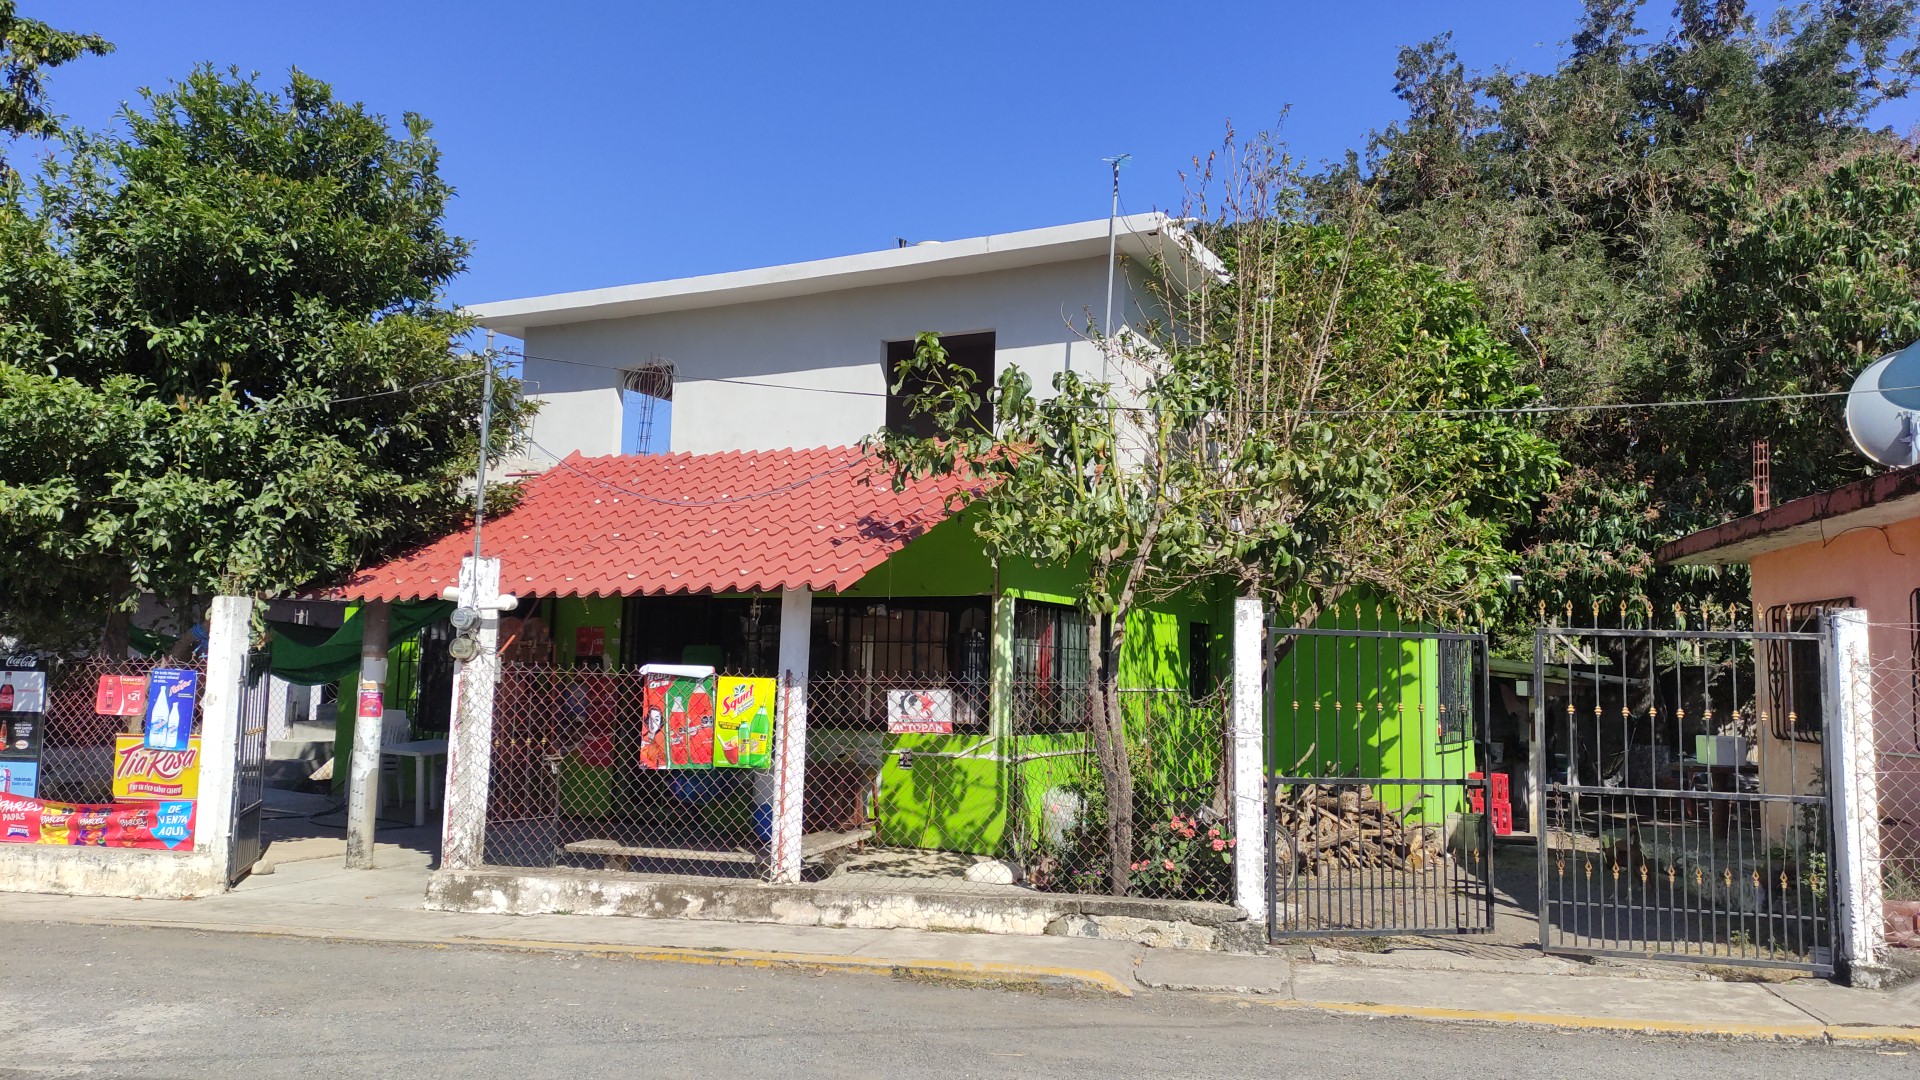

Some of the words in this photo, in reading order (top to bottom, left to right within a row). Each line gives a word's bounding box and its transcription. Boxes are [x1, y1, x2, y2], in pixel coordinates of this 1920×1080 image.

[722, 683, 756, 715] Squirt
[893, 723, 943, 731] ACTOPAN
[147, 749, 197, 779] Rosa
[153, 785, 166, 793] sabor
[167, 805, 182, 813] DE
[2, 812, 26, 821] PAPAS
[158, 815, 188, 825] VENTA
